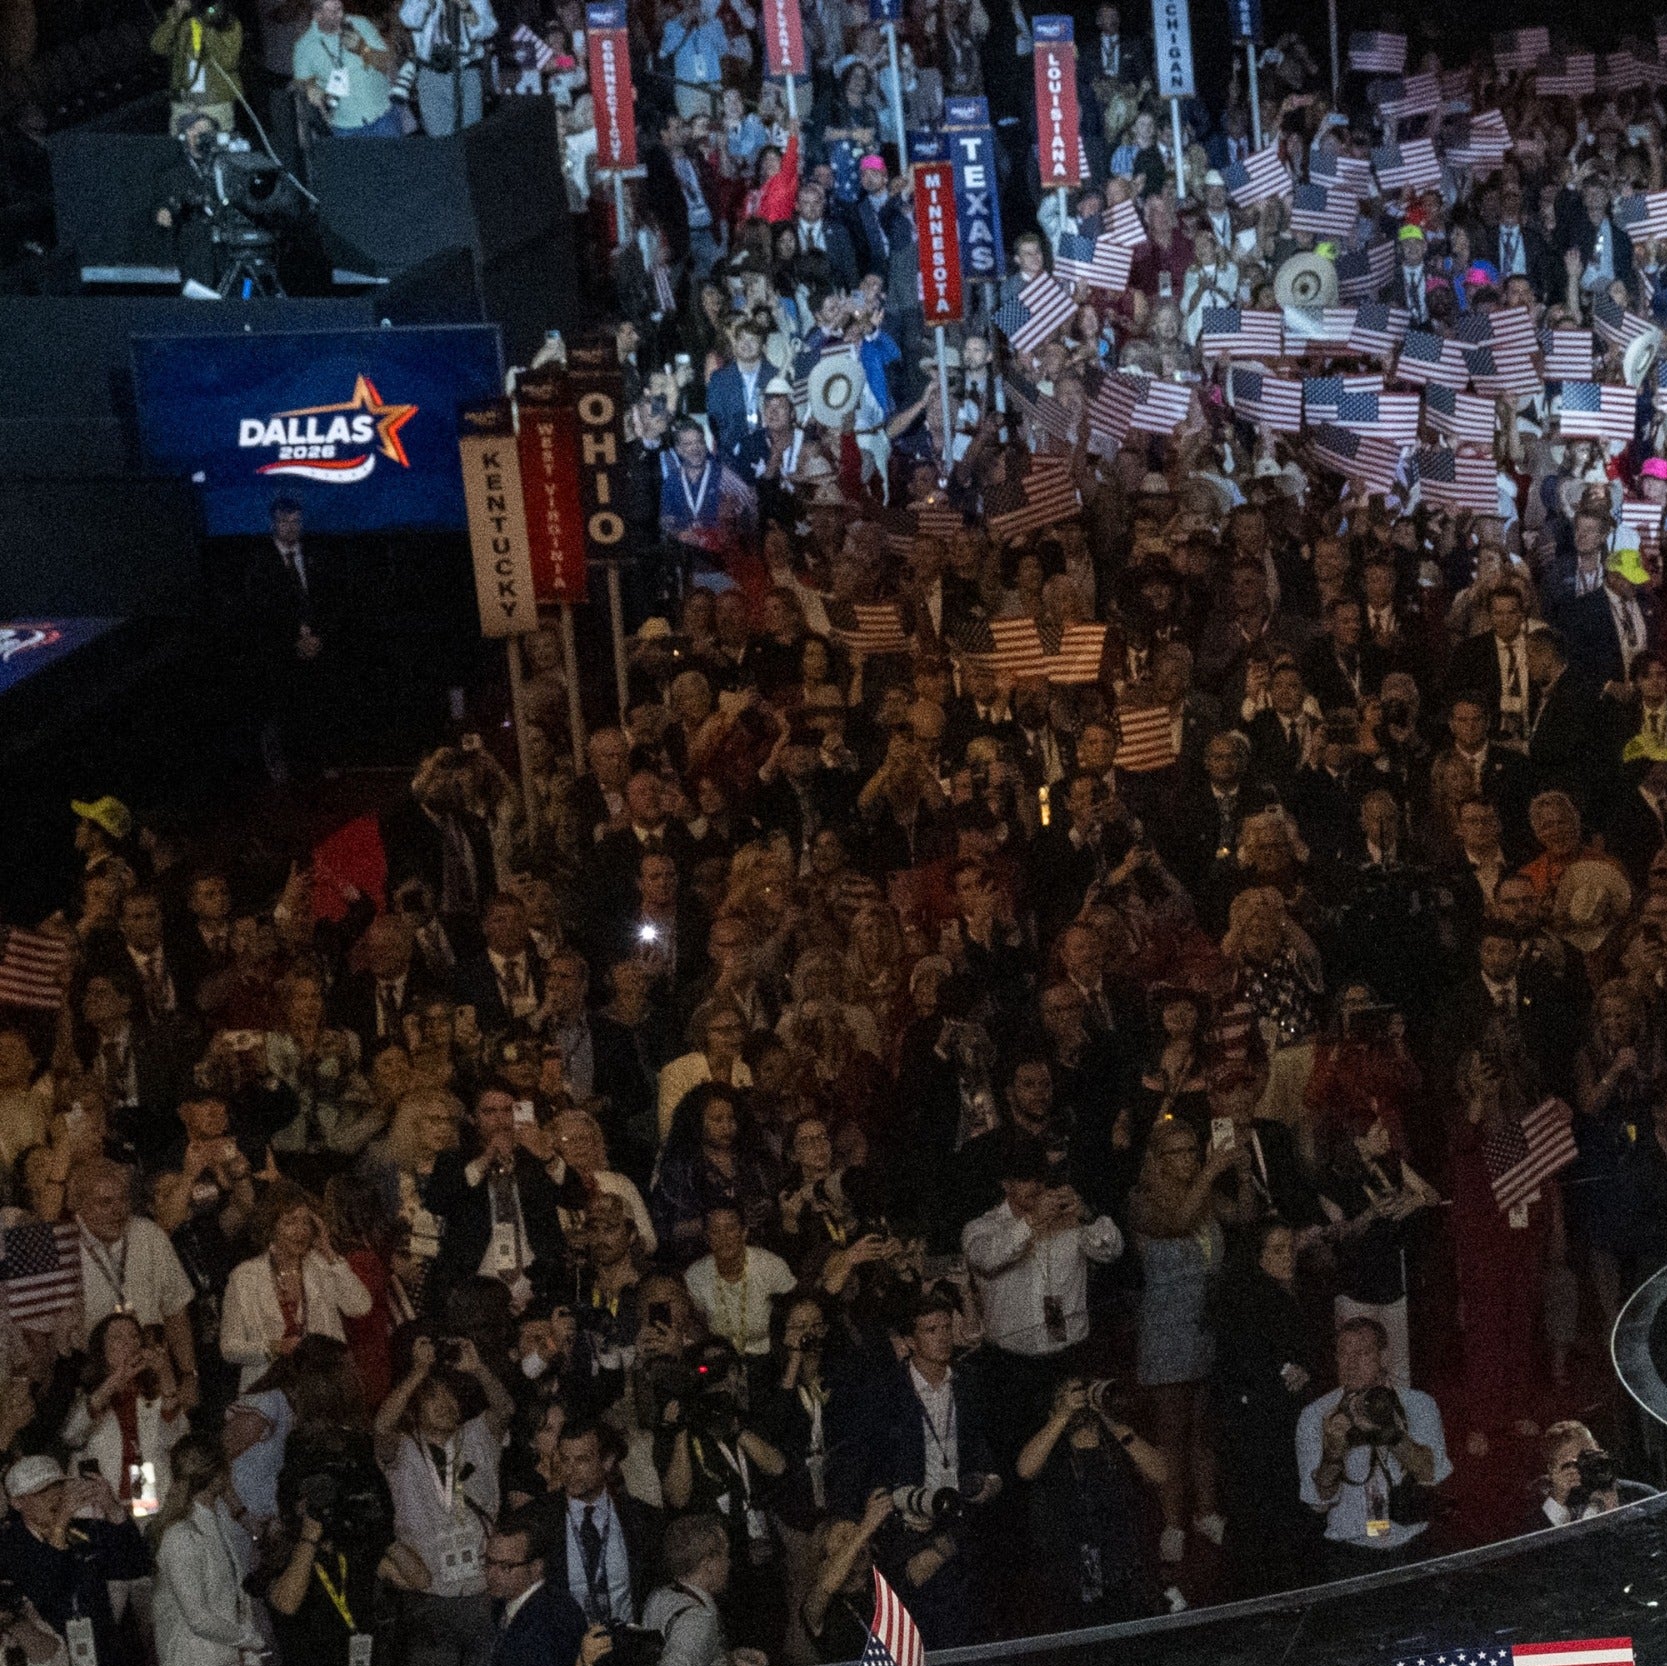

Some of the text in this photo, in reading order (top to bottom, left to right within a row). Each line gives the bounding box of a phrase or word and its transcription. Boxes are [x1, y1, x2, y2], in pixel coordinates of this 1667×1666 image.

[1048, 52, 1067, 177] LOUISIANA
[925, 173, 949, 312] MINNESOTA
[959, 137, 995, 272] TEXAS
[240, 413, 374, 450] DALLAS
[279, 447, 337, 461] 2026
[577, 391, 625, 545] OHIO
[482, 452, 517, 617] KENTUCKY
[537, 422, 568, 590] WEST VIRGINIA
